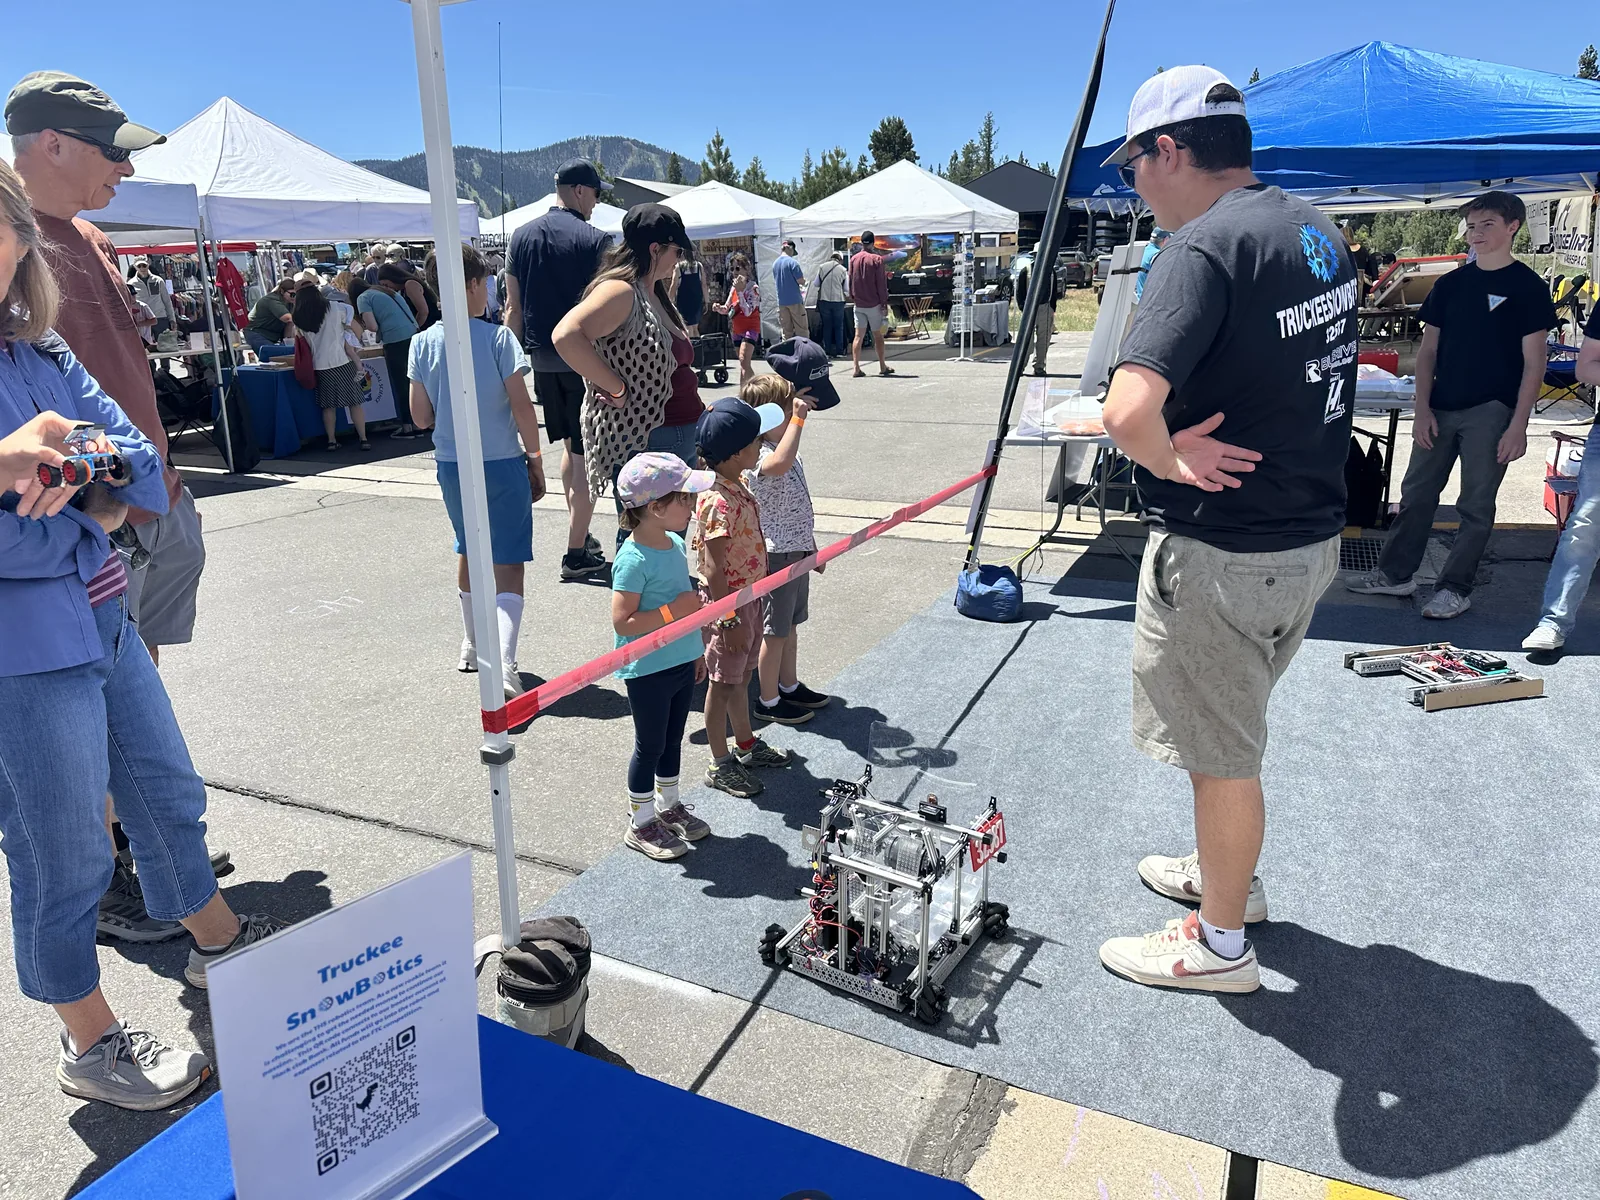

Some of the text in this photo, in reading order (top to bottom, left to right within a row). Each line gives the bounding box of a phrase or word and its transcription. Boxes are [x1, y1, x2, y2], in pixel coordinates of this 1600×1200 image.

[317, 936, 404, 984] Truckee
[271, 1036, 316, 1062] challenging
[325, 1025, 336, 1034] get
[338, 1019, 348, 1027] the
[349, 1006, 374, 1021] needed
[375, 994, 397, 1008] money
[406, 976, 432, 992] continue
[275, 1042, 286, 1051] We
[300, 1029, 312, 1038] the
[313, 1021, 326, 1031] THS
[328, 1007, 354, 1024] robotics
[390, 982, 402, 992] new
[404, 971, 424, 984] rookie
[298, 1047, 312, 1058] This
[312, 1041, 323, 1050] QR
[324, 1032, 340, 1044] code
[341, 1017, 369, 1035] connects
[378, 1007, 389, 1015] our
[341, 1030, 359, 1043] funds
[360, 1023, 373, 1032] will
[384, 1011, 397, 1020] into
[409, 995, 426, 1007] robot
[359, 1033, 370, 1042] the
[370, 1027, 381, 1036] FTC
